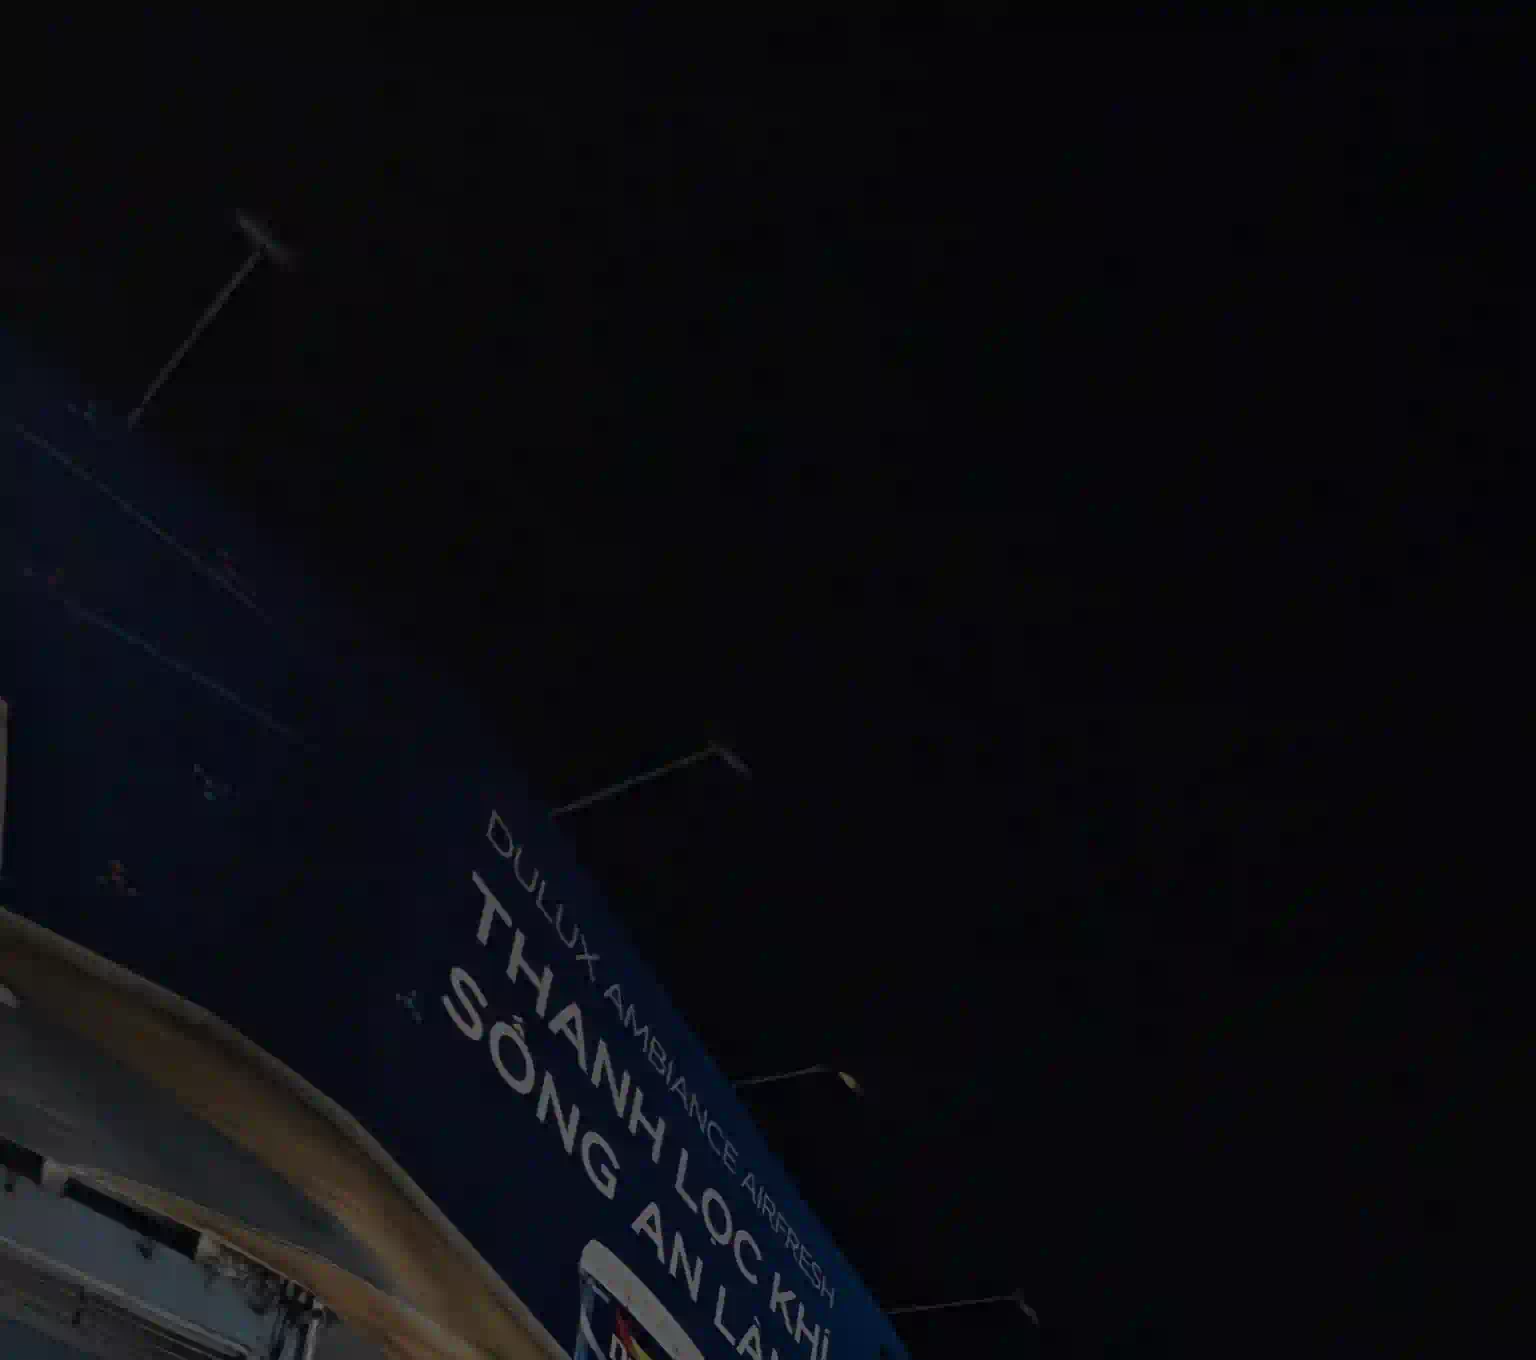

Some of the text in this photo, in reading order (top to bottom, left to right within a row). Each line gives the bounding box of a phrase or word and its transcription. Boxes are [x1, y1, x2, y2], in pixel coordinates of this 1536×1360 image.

[441, 966, 621, 1201] SỐNG
[631, 1202, 703, 1303] AN
[472, 869, 666, 1164] THANH
[675, 1148, 764, 1286] LỌC
[486, 810, 834, 1308] DULUX AMBIANCE AIRFRESH
